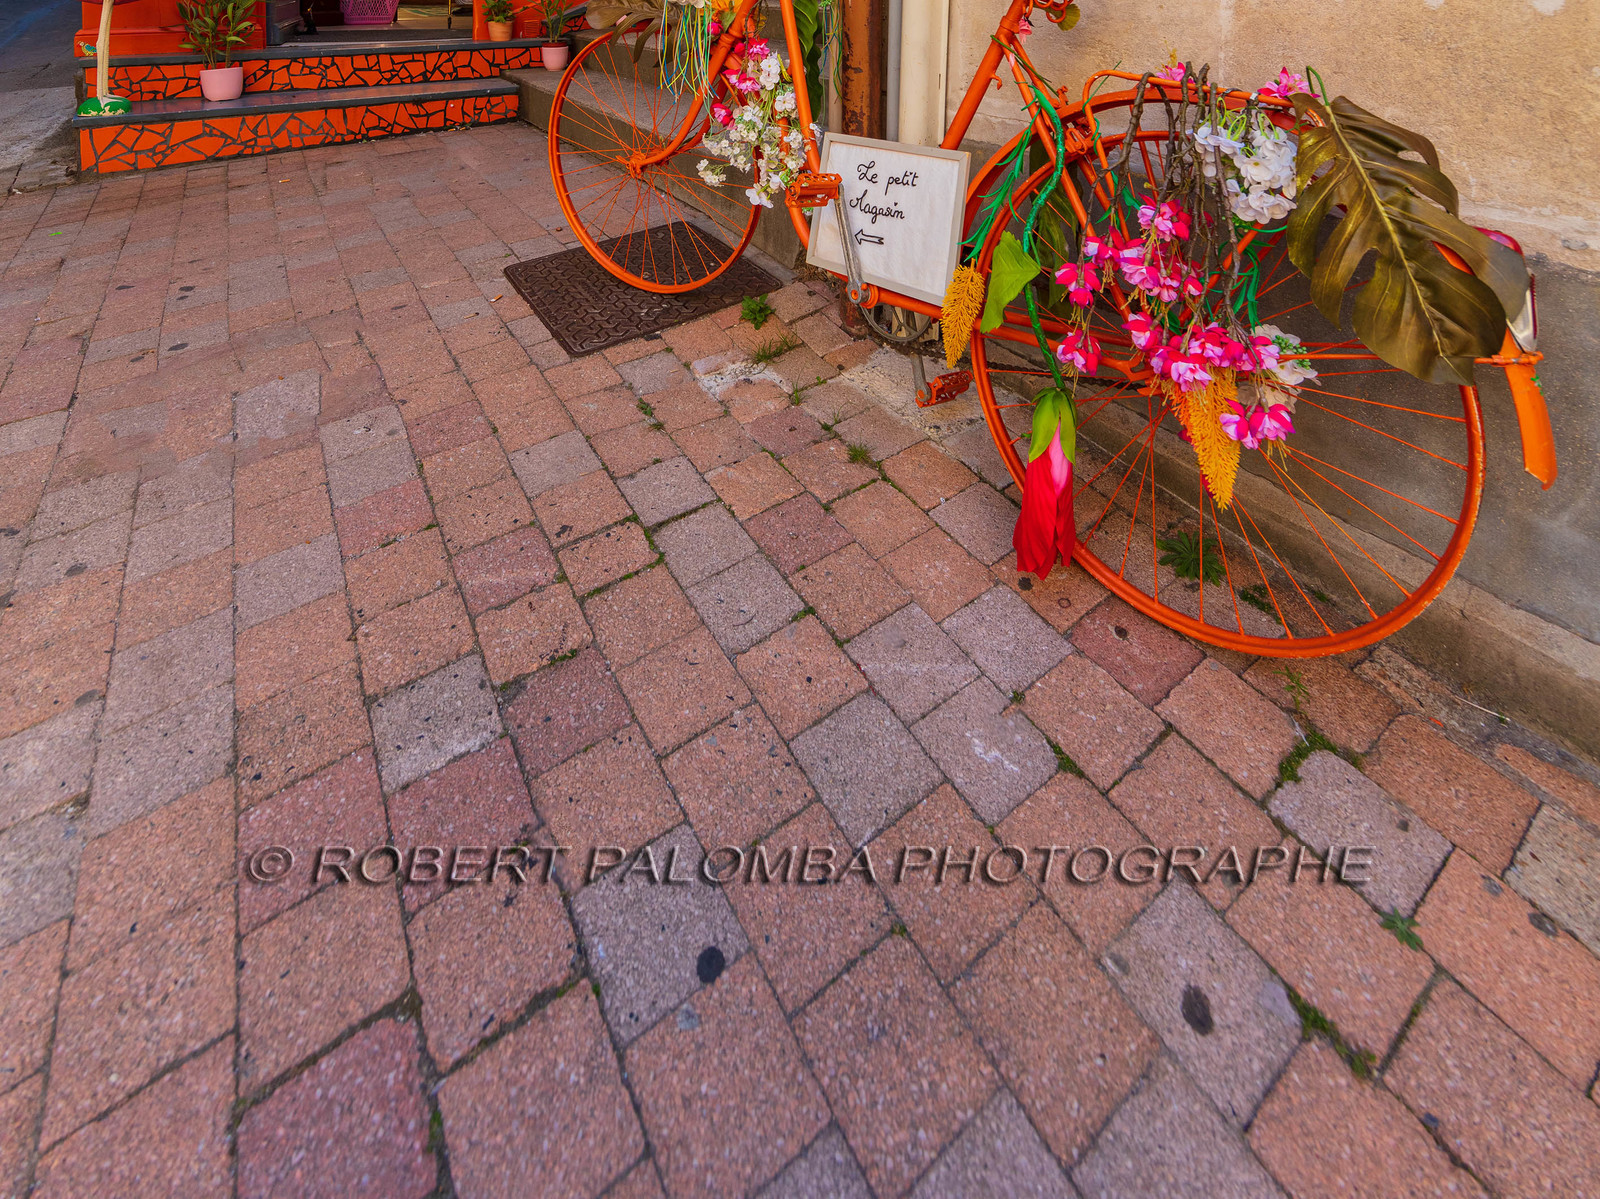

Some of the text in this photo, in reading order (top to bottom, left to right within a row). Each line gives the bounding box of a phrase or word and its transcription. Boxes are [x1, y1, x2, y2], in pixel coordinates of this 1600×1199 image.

[856, 160, 919, 196] Le petit
[849, 189, 905, 224] Magasin
